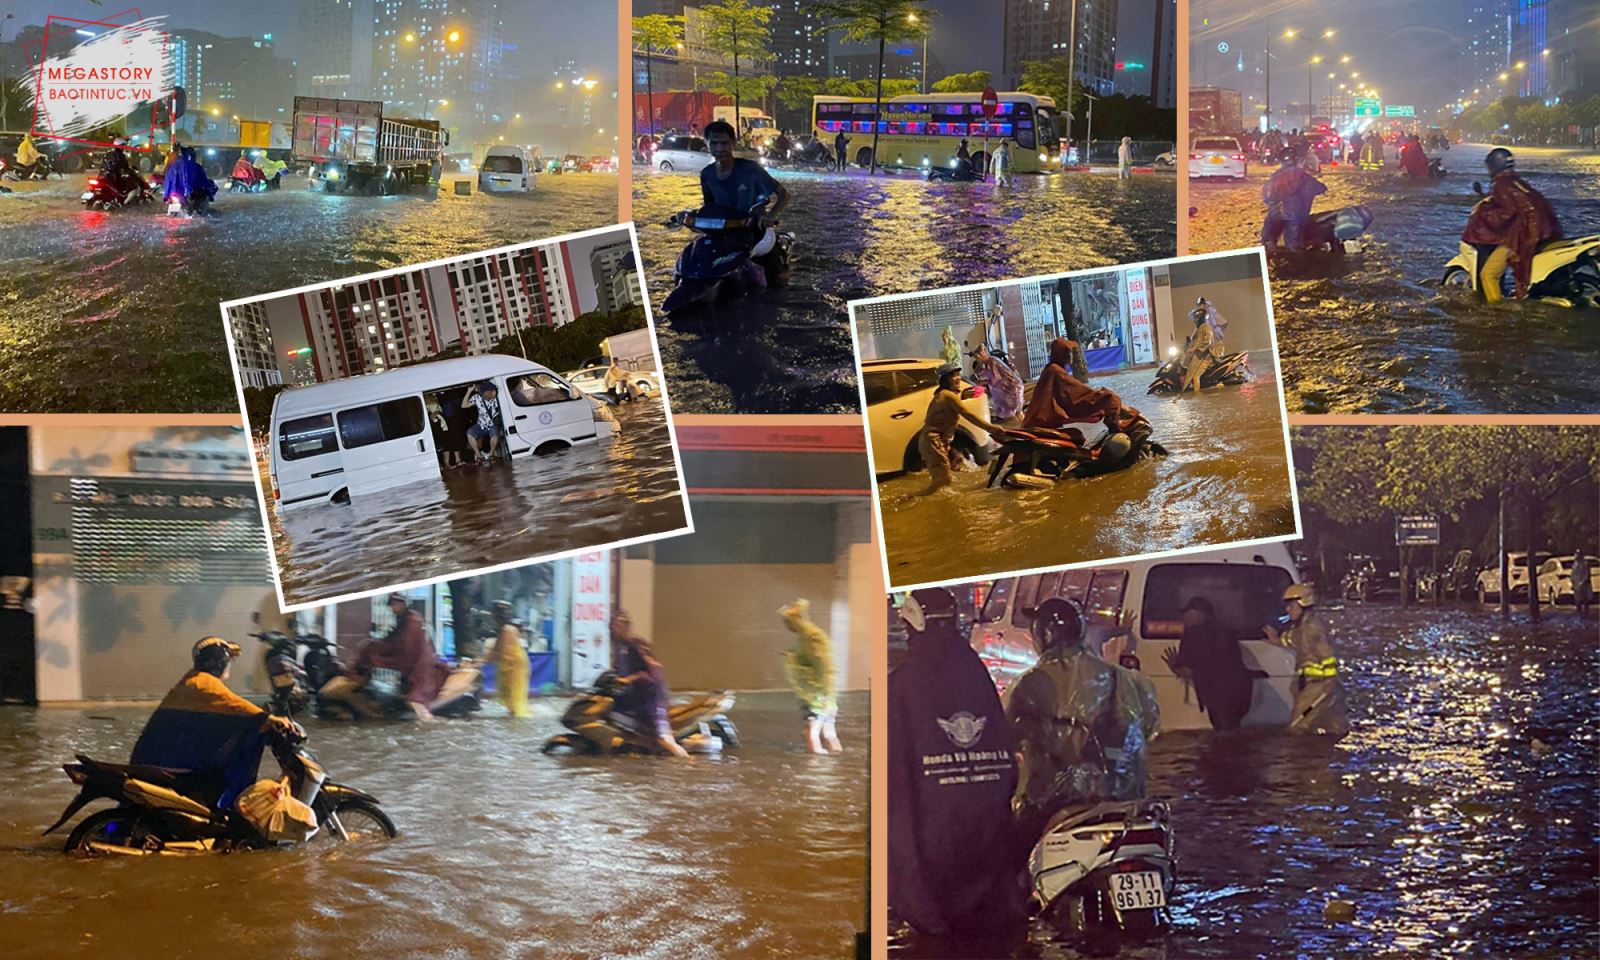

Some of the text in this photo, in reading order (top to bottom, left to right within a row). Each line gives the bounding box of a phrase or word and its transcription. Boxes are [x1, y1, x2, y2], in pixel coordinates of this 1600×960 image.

[923, 755, 953, 765] Honda
[1118, 873, 1155, 891] 29-T1
[1117, 889, 1161, 909] 961.37
